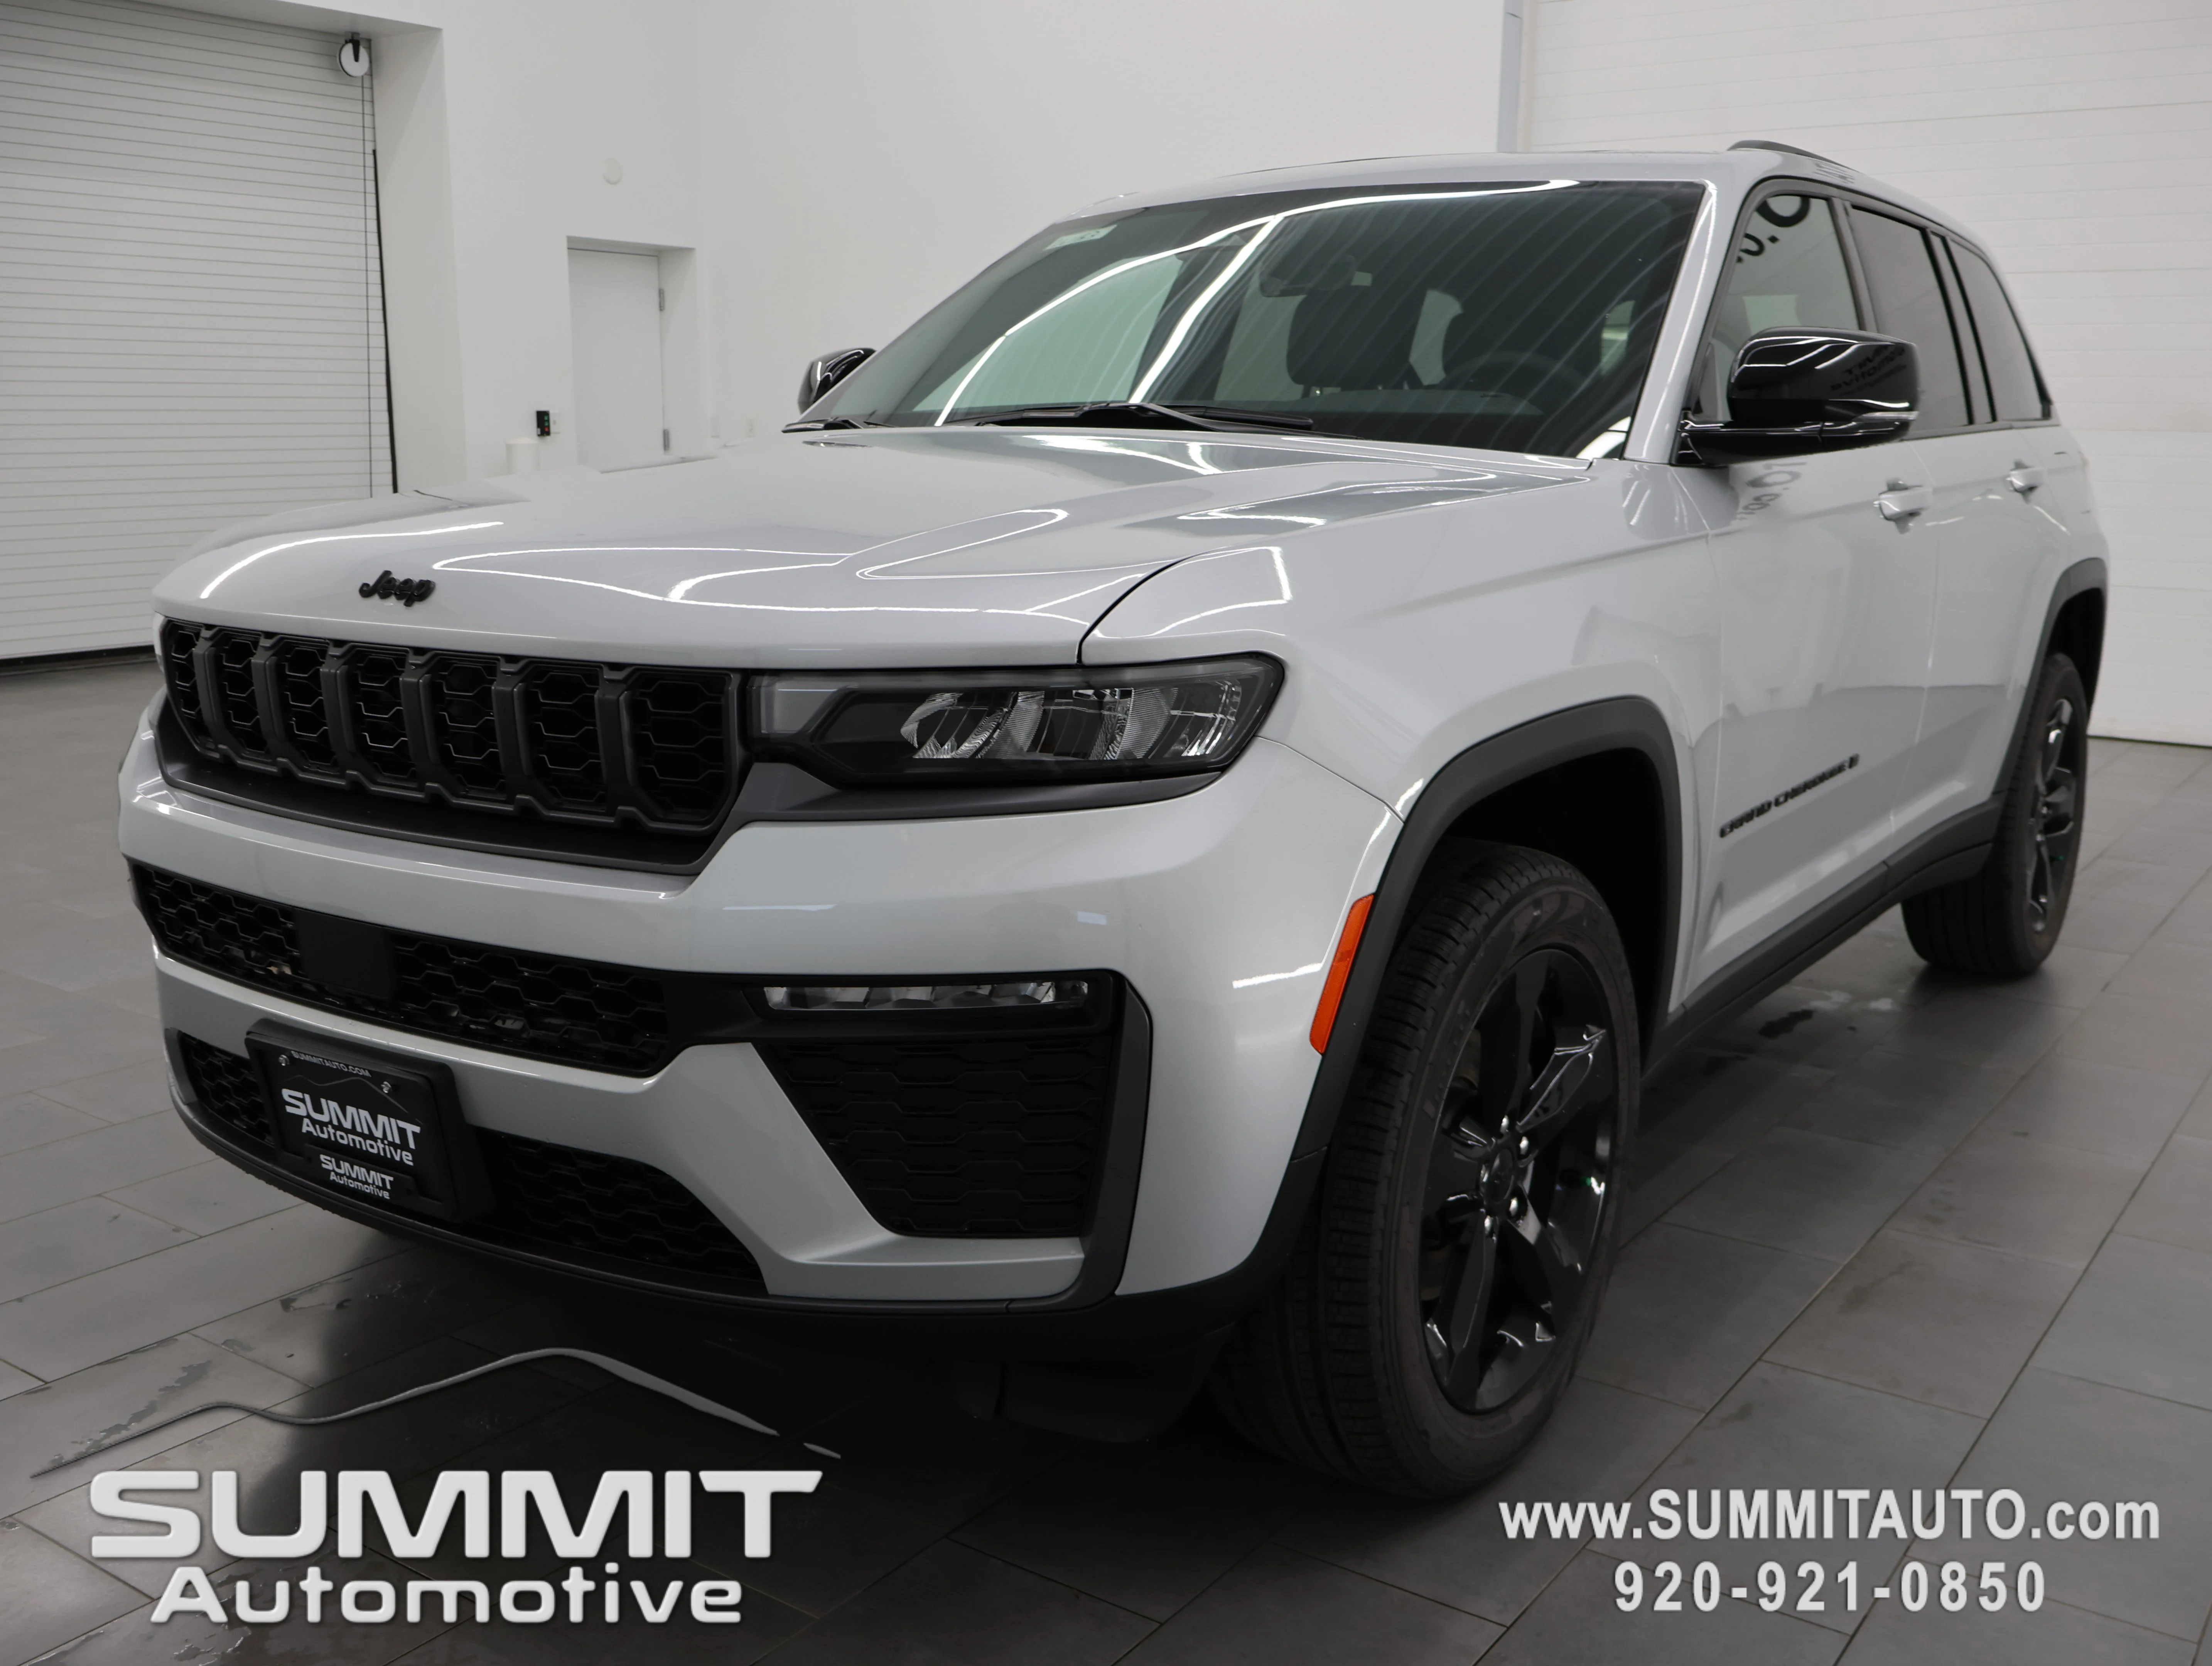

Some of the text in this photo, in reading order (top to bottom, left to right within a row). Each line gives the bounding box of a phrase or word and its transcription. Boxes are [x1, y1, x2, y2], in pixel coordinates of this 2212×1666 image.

[359, 570, 436, 607] Jeep
[291, 1050, 372, 1077] SUMMITAUTO.COM
[282, 1088, 421, 1149] SUMMIT
[301, 1118, 414, 1166] Automotive
[319, 1154, 394, 1190] SUMMIT
[330, 1171, 390, 1200] Automotive
